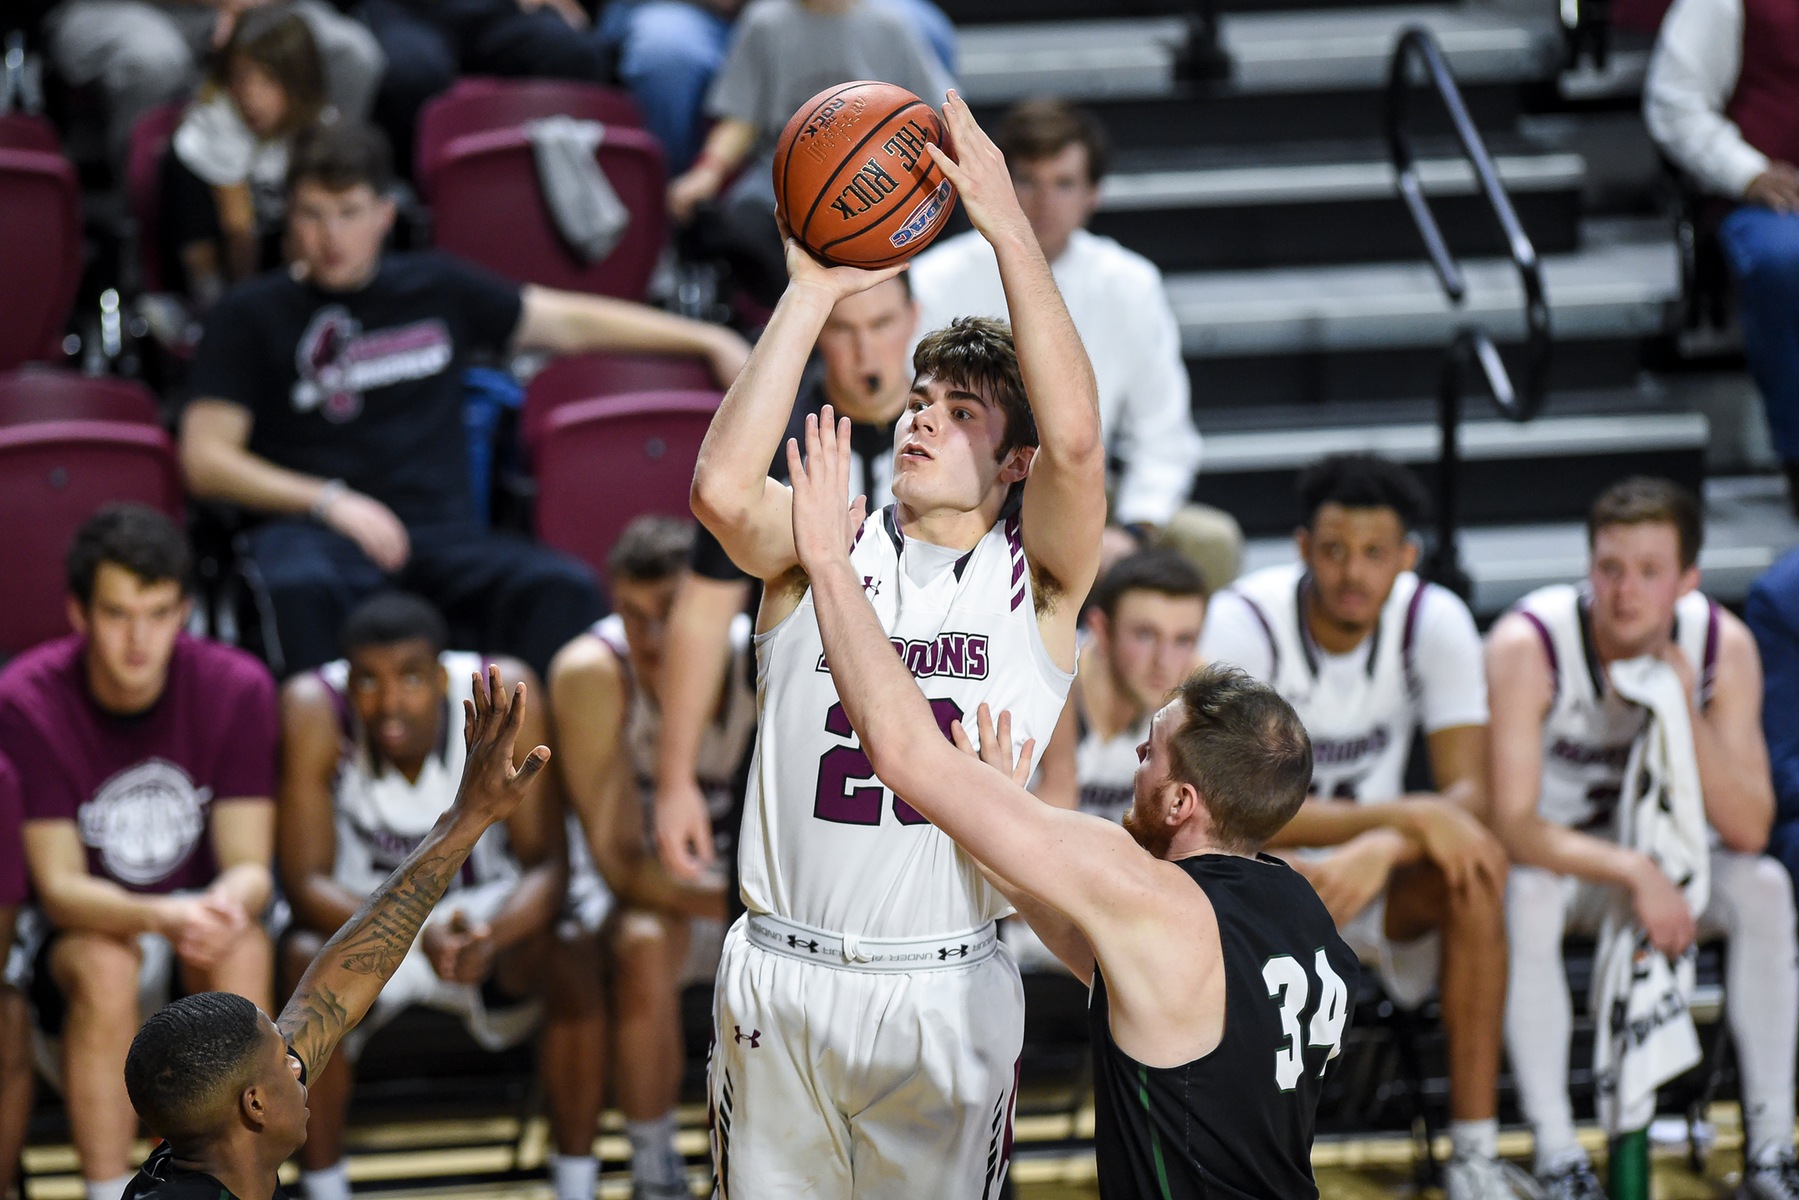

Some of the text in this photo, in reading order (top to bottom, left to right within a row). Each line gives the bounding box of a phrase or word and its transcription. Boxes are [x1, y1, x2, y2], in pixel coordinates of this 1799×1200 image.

[804, 98, 845, 139] ROCK
[830, 119, 928, 220] THE ROCK
[889, 952, 934, 962] UNDER
[1261, 946, 1348, 1093] 34
